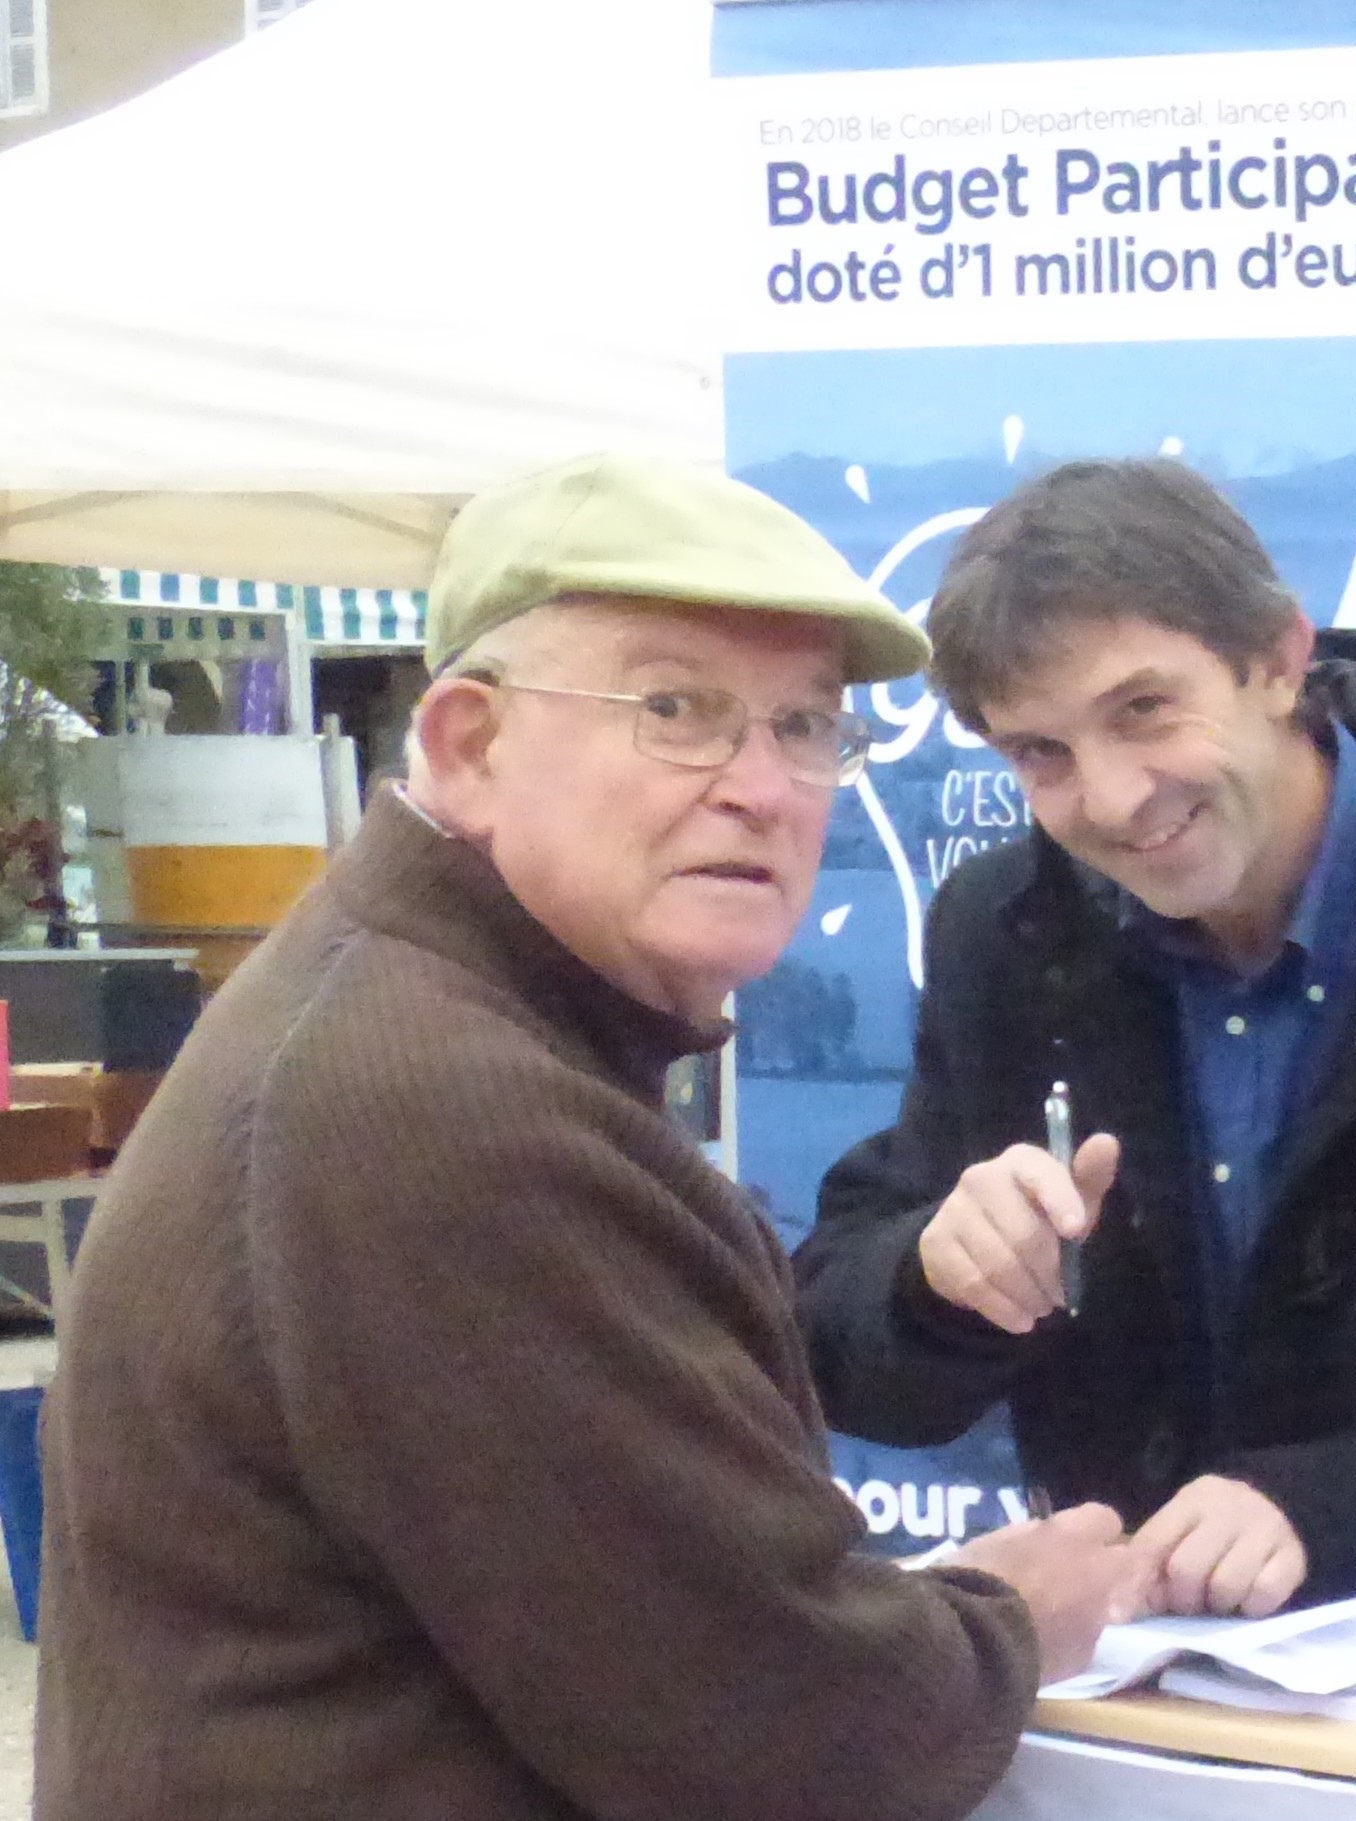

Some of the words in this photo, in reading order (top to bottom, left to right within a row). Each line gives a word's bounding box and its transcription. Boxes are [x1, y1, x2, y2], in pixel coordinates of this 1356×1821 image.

[759, 119, 794, 146] En
[801, 116, 863, 144] 2018
[871, 116, 892, 141] le
[899, 110, 993, 139] Conseil
[1217, 98, 1290, 124] lance
[1298, 99, 1347, 122] son
[767, 153, 1030, 236] Budget
[767, 242, 902, 304] doté
[919, 242, 992, 299] d'1
[1014, 235, 1217, 296] million
[832, 1476, 982, 1539] our
